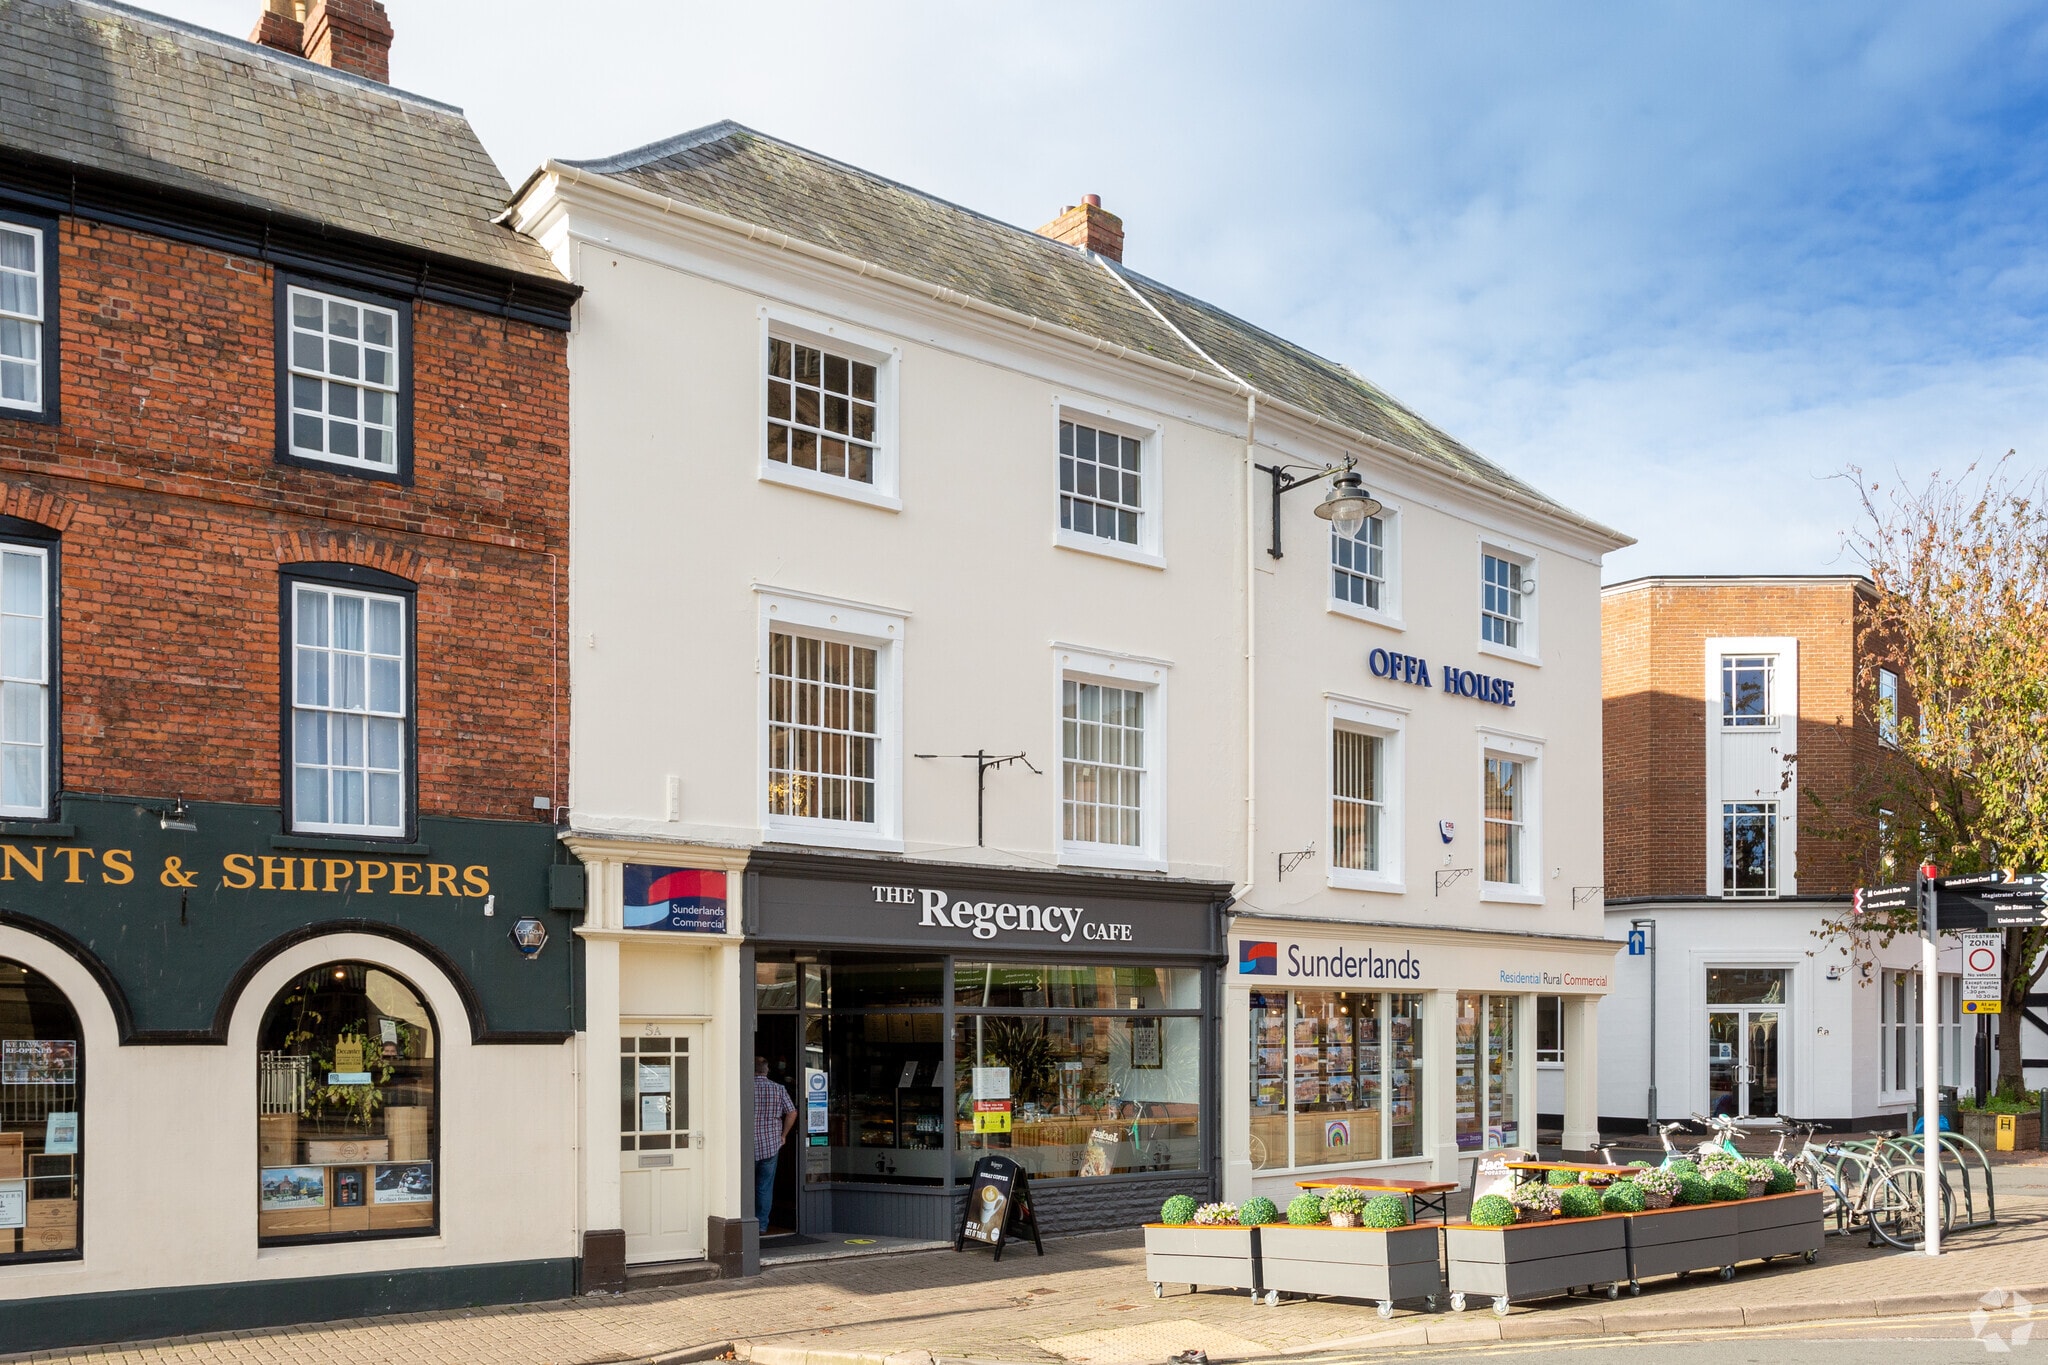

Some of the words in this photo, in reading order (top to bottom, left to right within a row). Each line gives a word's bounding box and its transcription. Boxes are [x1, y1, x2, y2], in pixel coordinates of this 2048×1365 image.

[1369, 648, 1432, 687] OFFA
[1443, 665, 1516, 707] HOUSE
[0, 845, 134, 884] NTS
[160, 856, 198, 888] &
[222, 853, 490, 898] SHIPPERS
[672, 904, 724, 916] Sunderlands
[872, 886, 915, 904] THE
[918, 888, 1084, 942] Regency
[1083, 923, 1132, 941] CAFE
[672, 917, 724, 928] Commercial
[1288, 944, 1420, 980] Sunderlands
[1500, 970, 1540, 984] Residential
[1543, 972, 1562, 984] Rural
[1564, 973, 1608, 986] Commercial
[646, 1023, 662, 1036] 5A
[2001, 1119, 2010, 1130] H
